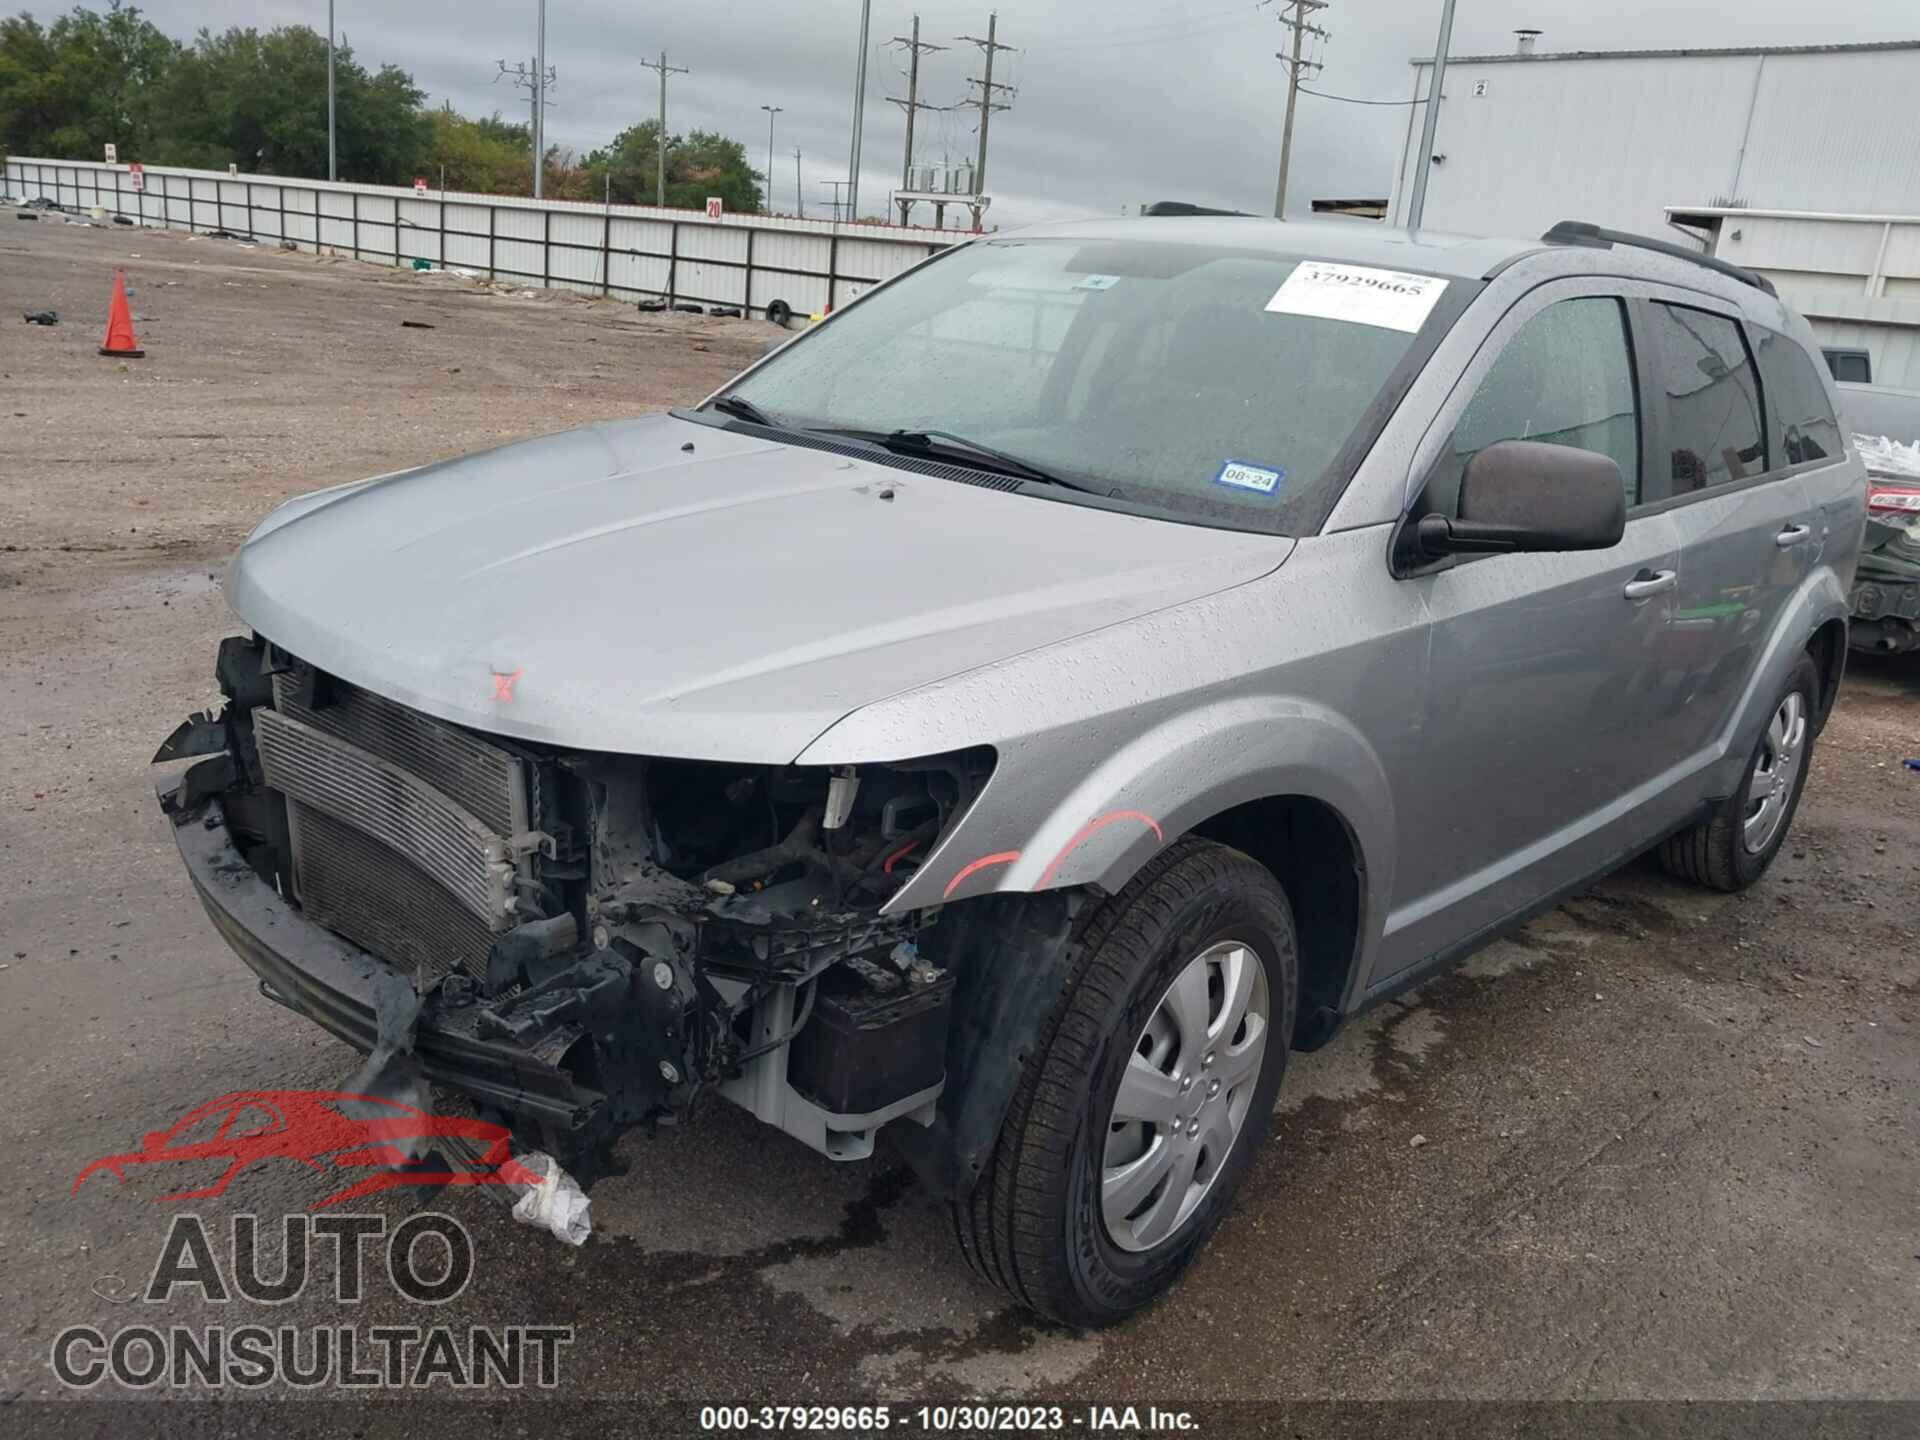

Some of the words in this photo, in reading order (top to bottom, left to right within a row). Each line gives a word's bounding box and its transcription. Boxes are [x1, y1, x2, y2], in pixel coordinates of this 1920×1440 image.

[1476, 84, 1484, 95] 2
[708, 201, 720, 218] 20
[1304, 270, 1423, 297] 37929665
